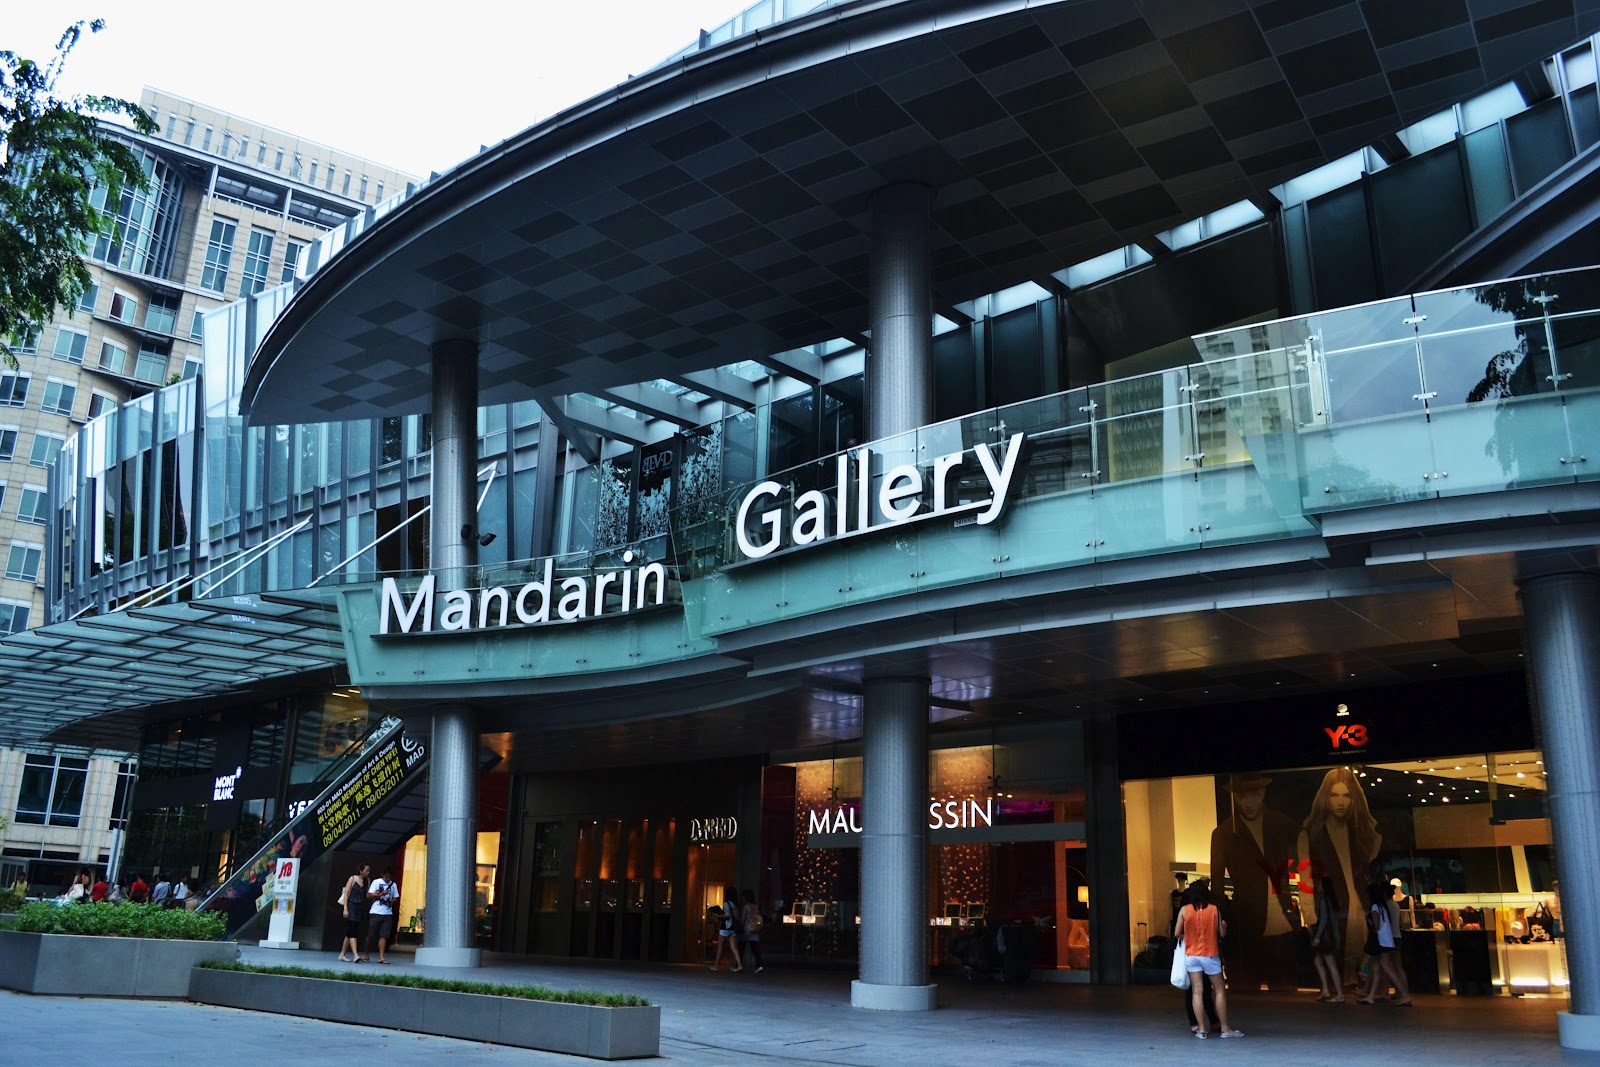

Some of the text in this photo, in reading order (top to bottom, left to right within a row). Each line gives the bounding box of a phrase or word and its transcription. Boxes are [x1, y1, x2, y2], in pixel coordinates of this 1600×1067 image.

[379, 432, 1025, 635] Mandarin Gallery
[405, 745, 425, 768] MAD
[1323, 725, 1368, 748] Y-3
[215, 775, 236, 788] MONT
[331, 789, 343, 802] MAD
[342, 771, 362, 791] Museum
[361, 766, 368, 774] of
[367, 760, 376, 769] Art
[379, 740, 396, 757] Design
[213, 787, 235, 801] BLANC
[318, 814, 325, 824] IN
[324, 800, 342, 817] LOVING
[341, 781, 363, 803] MEMORY
[363, 771, 371, 782] OF
[370, 761, 386, 776] CHEN
[322, 808, 361, 848] 09/04/2011
[365, 768, 405, 808] 09/05/2011
